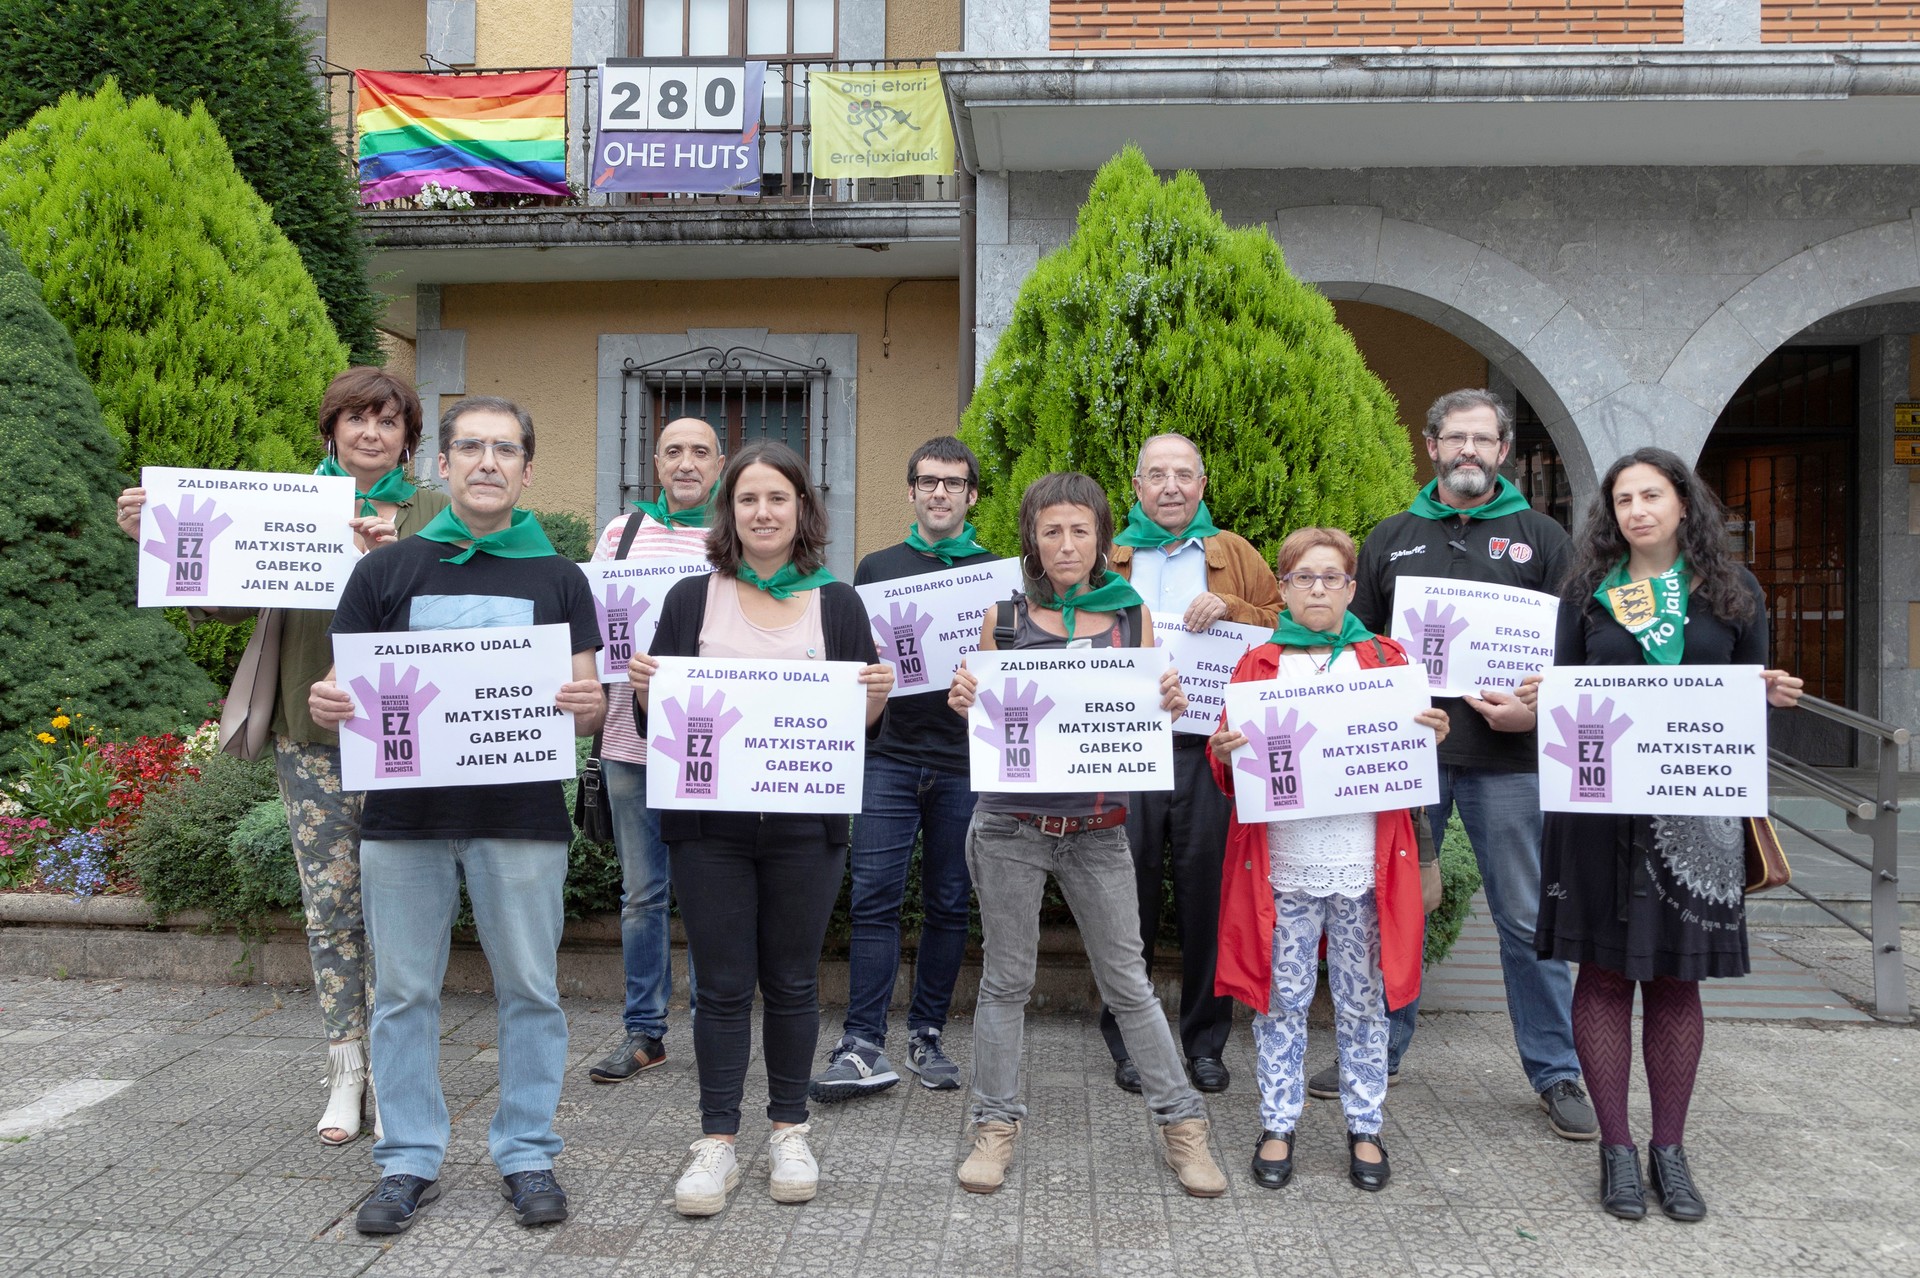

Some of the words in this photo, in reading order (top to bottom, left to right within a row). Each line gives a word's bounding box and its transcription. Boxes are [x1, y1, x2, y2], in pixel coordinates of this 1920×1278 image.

[609, 77, 738, 120] 280
[603, 142, 664, 167] OHE
[674, 142, 750, 170] HUTS
[830, 148, 938, 167] errefuxiatuak
[178, 479, 268, 491] ZALDIBARKO
[273, 483, 318, 493] UDALA
[264, 522, 316, 533] ERASO
[177, 538, 202, 558] EZ
[235, 540, 344, 554] MATXISTARIK
[1513, 547, 1528, 559] MG
[176, 562, 202, 580] NO
[256, 560, 322, 572] GABEKO
[602, 566, 675, 578] ZALDIBARKO
[680, 565, 717, 573] UDALA
[241, 579, 288, 591] JAIEN
[294, 581, 334, 592] ALDE
[884, 579, 953, 598] ZALDIBARKO
[957, 572, 993, 584] UDALA
[1660, 568, 1682, 617] jaiak
[1425, 587, 1499, 600] ZALDIBARKO
[1504, 594, 1541, 606] UDALA
[958, 608, 988, 621] ERAS
[608, 622, 629, 641] EZ
[1208, 628, 1243, 640] UDALA
[1496, 627, 1540, 639] ERASO
[374, 641, 475, 655] ZALDIBARKO
[481, 639, 532, 651] UDALA
[610, 643, 631, 660] NO
[896, 638, 917, 657] EZ
[1423, 638, 1444, 656] EZ
[1470, 641, 1552, 657] MATXISTARI
[900, 658, 921, 674] NO
[1001, 660, 1086, 671] ZALDIBARKO
[1091, 659, 1135, 669] UDALA
[687, 669, 778, 681] ZALDIBARKO
[783, 672, 830, 682] UDALA
[1475, 677, 1515, 687] JAIEN
[1575, 678, 1668, 687] ZALDIBARKO
[1674, 678, 1723, 687] UDALA
[475, 685, 533, 699] ERASO
[1260, 684, 1344, 701] ZALDIBARKO
[1350, 679, 1394, 692] UDALA
[445, 706, 564, 723] MATXISTARIK
[1085, 702, 1135, 712] ERASO
[1181, 709, 1210, 720] AIEN
[382, 713, 411, 735] EZ
[774, 717, 828, 728] ERASO
[1059, 721, 1162, 733] MATXISTARIK
[1348, 721, 1398, 735] ERASO
[1667, 722, 1723, 732] ERASO
[470, 729, 542, 744] GABEKO
[1005, 723, 1029, 744] EZ
[384, 739, 412, 760] NO
[687, 735, 712, 757] EZ
[745, 738, 855, 751] MATXISTARIK
[1080, 742, 1142, 753] GABEKO
[1323, 738, 1427, 758] MATXISTARIK
[1578, 741, 1604, 762] EZ
[1638, 743, 1756, 755] MATXISTARIK
[456, 753, 507, 766] JAIEN
[513, 750, 557, 763] ALDE
[1006, 748, 1030, 767] NO
[1269, 750, 1294, 773] EZ
[686, 761, 712, 782] NO
[766, 760, 833, 772] GABEKO
[1068, 764, 1112, 774] JAIEN
[1117, 762, 1156, 772] ALDE
[1345, 760, 1408, 776] GABEKO
[1660, 765, 1732, 775] GABEKO
[1579, 767, 1605, 786] NO
[751, 782, 799, 793] JAIEN
[804, 783, 845, 794] ALDE
[1271, 775, 1297, 795] NO
[1334, 783, 1379, 797] JAIEN
[1385, 779, 1422, 792] ALDE
[1646, 786, 1696, 796] JAIEN
[1703, 787, 1747, 797] ALDE
